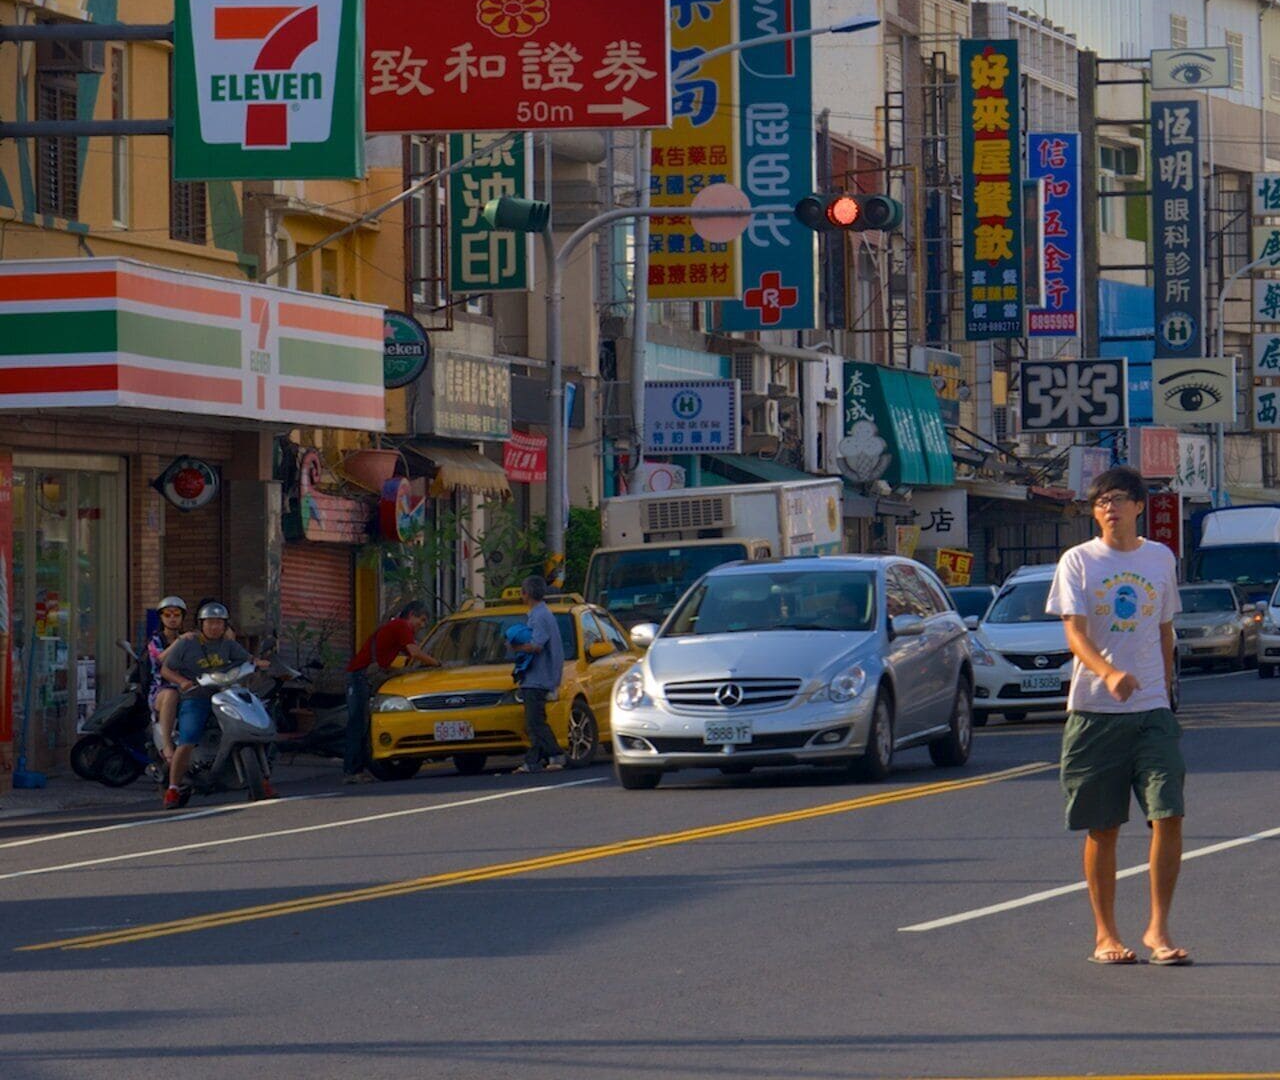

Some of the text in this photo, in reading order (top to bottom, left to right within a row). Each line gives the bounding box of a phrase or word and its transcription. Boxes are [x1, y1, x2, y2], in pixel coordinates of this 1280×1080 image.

[368, 39, 658, 97] 致和證券
[516, 101, 574, 123] 50m
[1026, 363, 1120, 427] 粥
